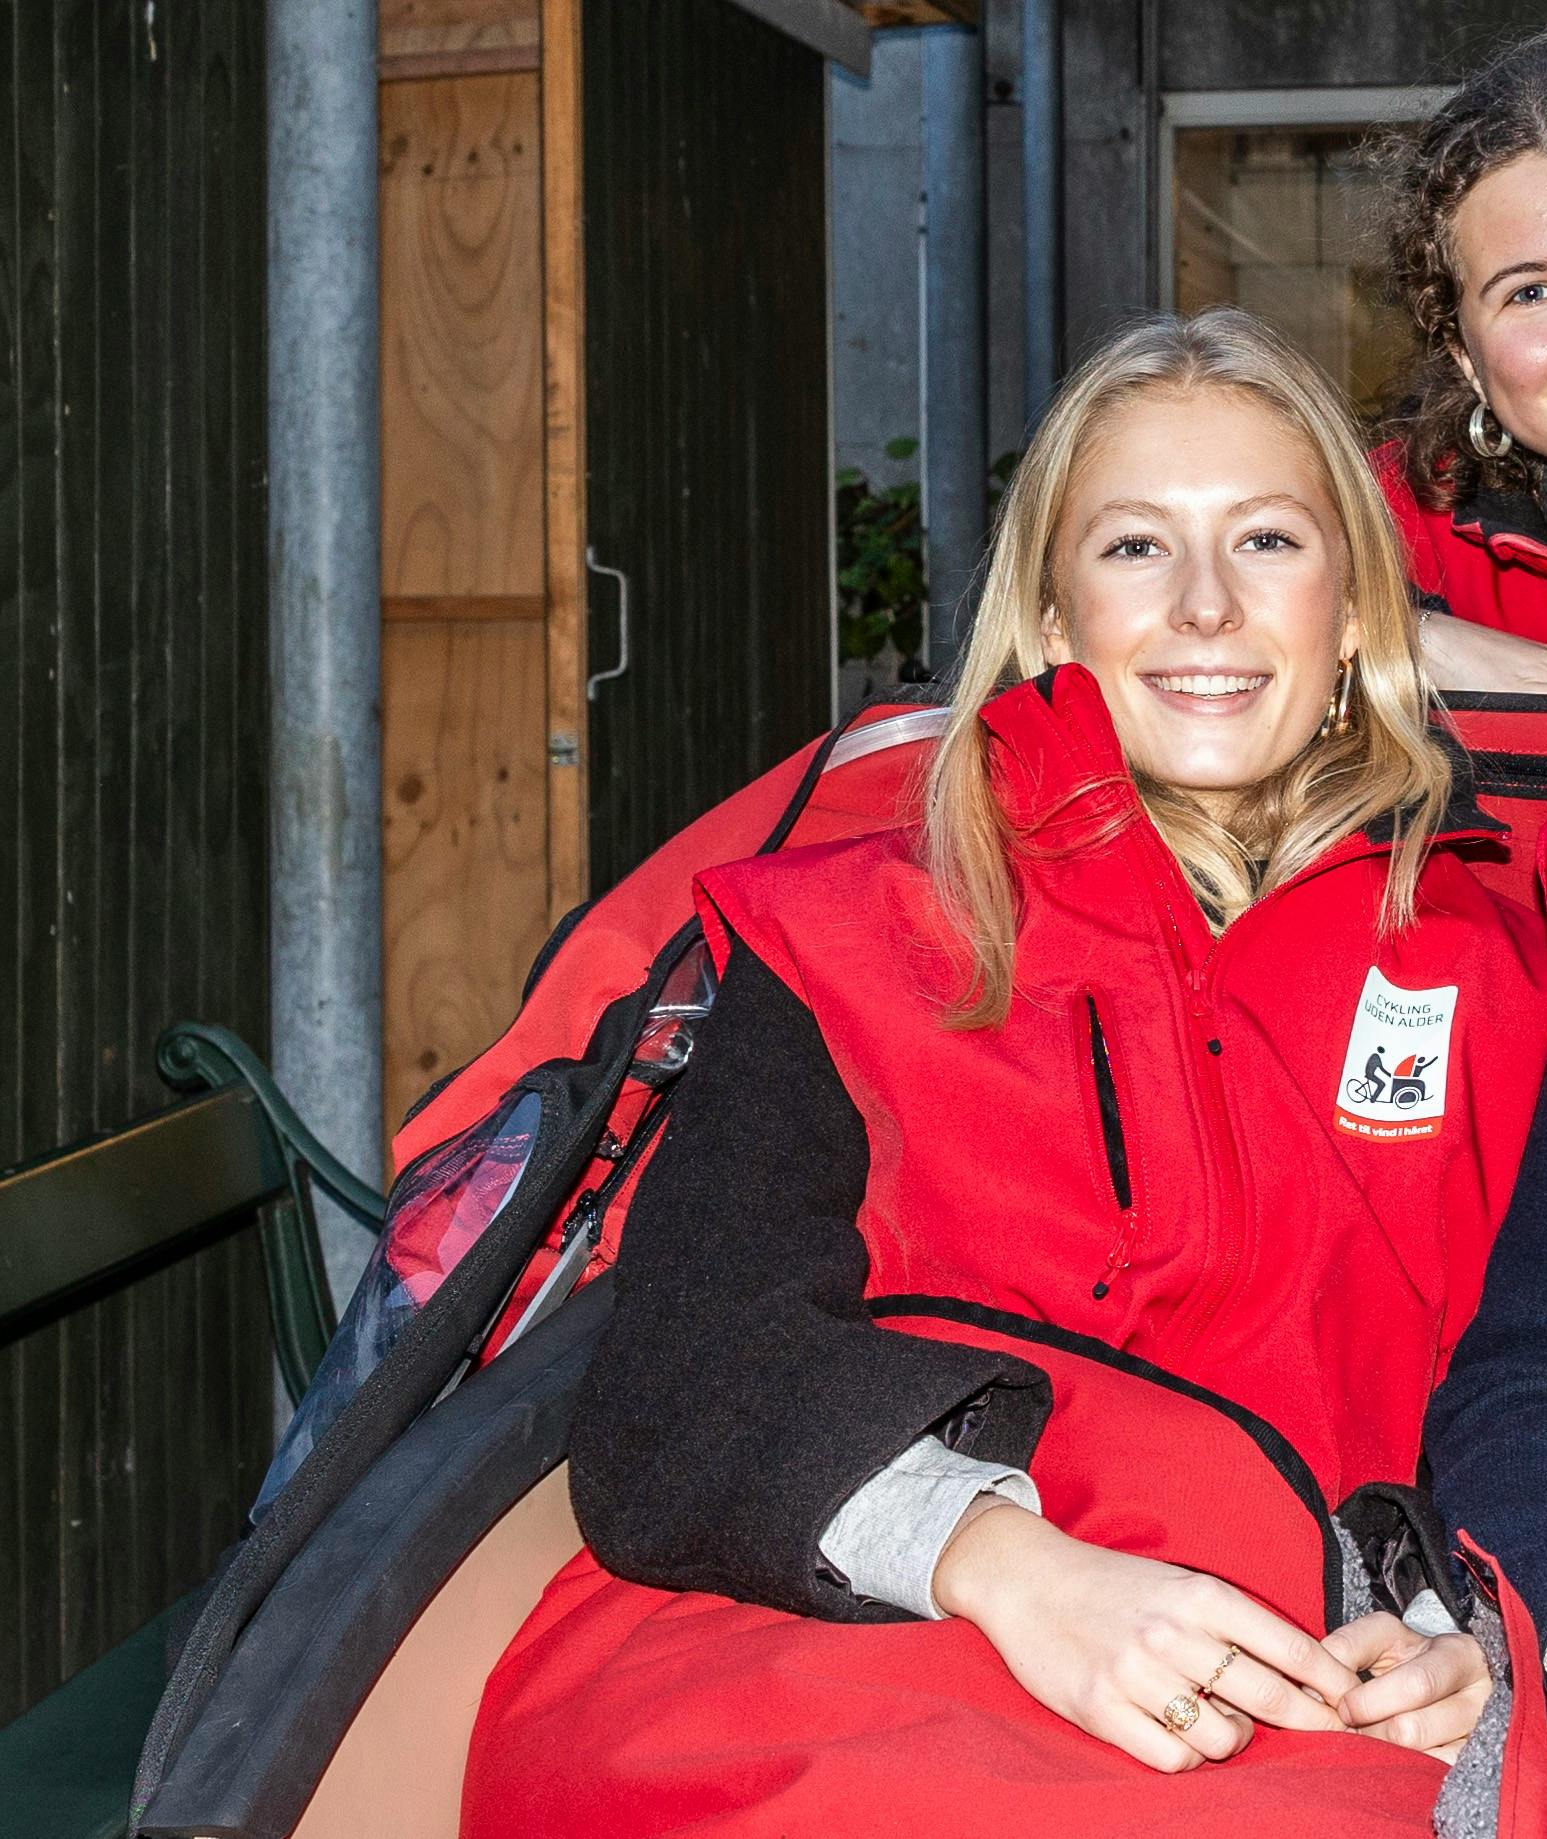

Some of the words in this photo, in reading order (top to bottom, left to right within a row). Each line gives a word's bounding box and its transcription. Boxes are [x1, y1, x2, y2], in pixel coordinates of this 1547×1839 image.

[1364, 999, 1395, 1025] UDEN
[1397, 1013, 1444, 1028] ALDER
[1376, 994, 1432, 1014] CYKLING
[1338, 1116, 1358, 1131] Ret
[1358, 1124, 1371, 1135] til
[1372, 1126, 1397, 1137] vind
[1403, 1124, 1433, 1136] håret
